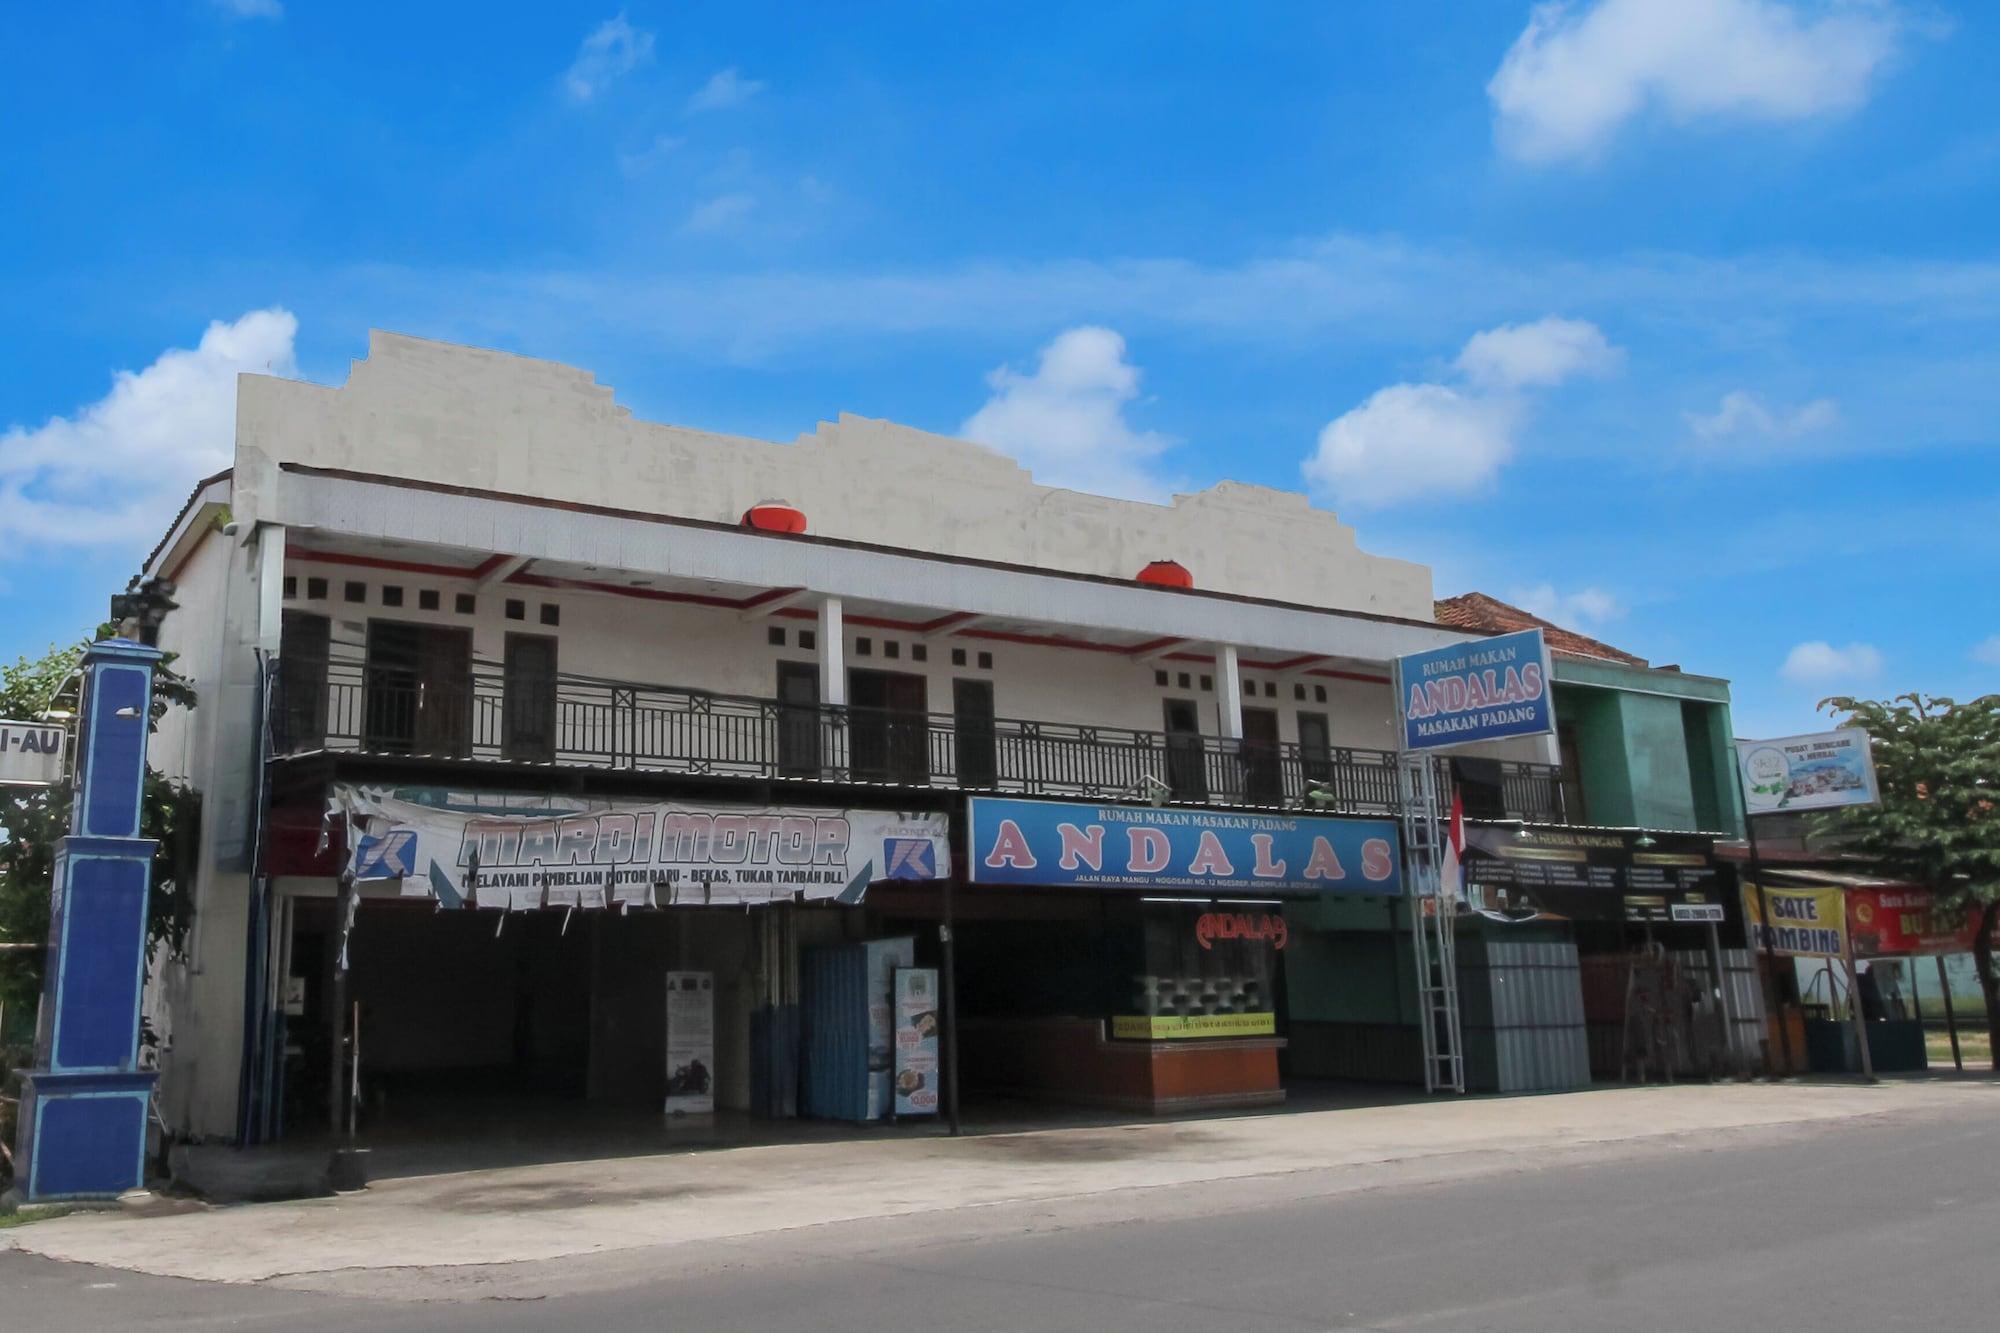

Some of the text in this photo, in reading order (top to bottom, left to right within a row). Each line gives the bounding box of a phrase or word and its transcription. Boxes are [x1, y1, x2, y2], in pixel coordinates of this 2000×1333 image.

[1422, 647, 1517, 677] RUMAH MAKAN
[1407, 662, 1543, 720] ANDALAS
[1417, 706, 1536, 736] MASAKAN PADANG
[1098, 809, 1297, 832] RUMAH MAKAN MASAKAN PADANG
[456, 811, 852, 868] MARDI MOTOR
[985, 818, 1393, 881] ANDALAS
[532, 871, 603, 887] PEMBELIAN
[649, 869, 680, 883] BARU
[691, 869, 733, 884] BEKAS,
[735, 869, 774, 883] TUKAR
[776, 869, 822, 884] TAMBAH
[824, 870, 844, 884] DLL
[1074, 874, 1100, 883] JALAN
[1101, 875, 1120, 883] RAYA
[1122, 876, 1150, 884] MANGU
[1772, 896, 1818, 920] SATE
[1196, 912, 1288, 951] ANDALAS
